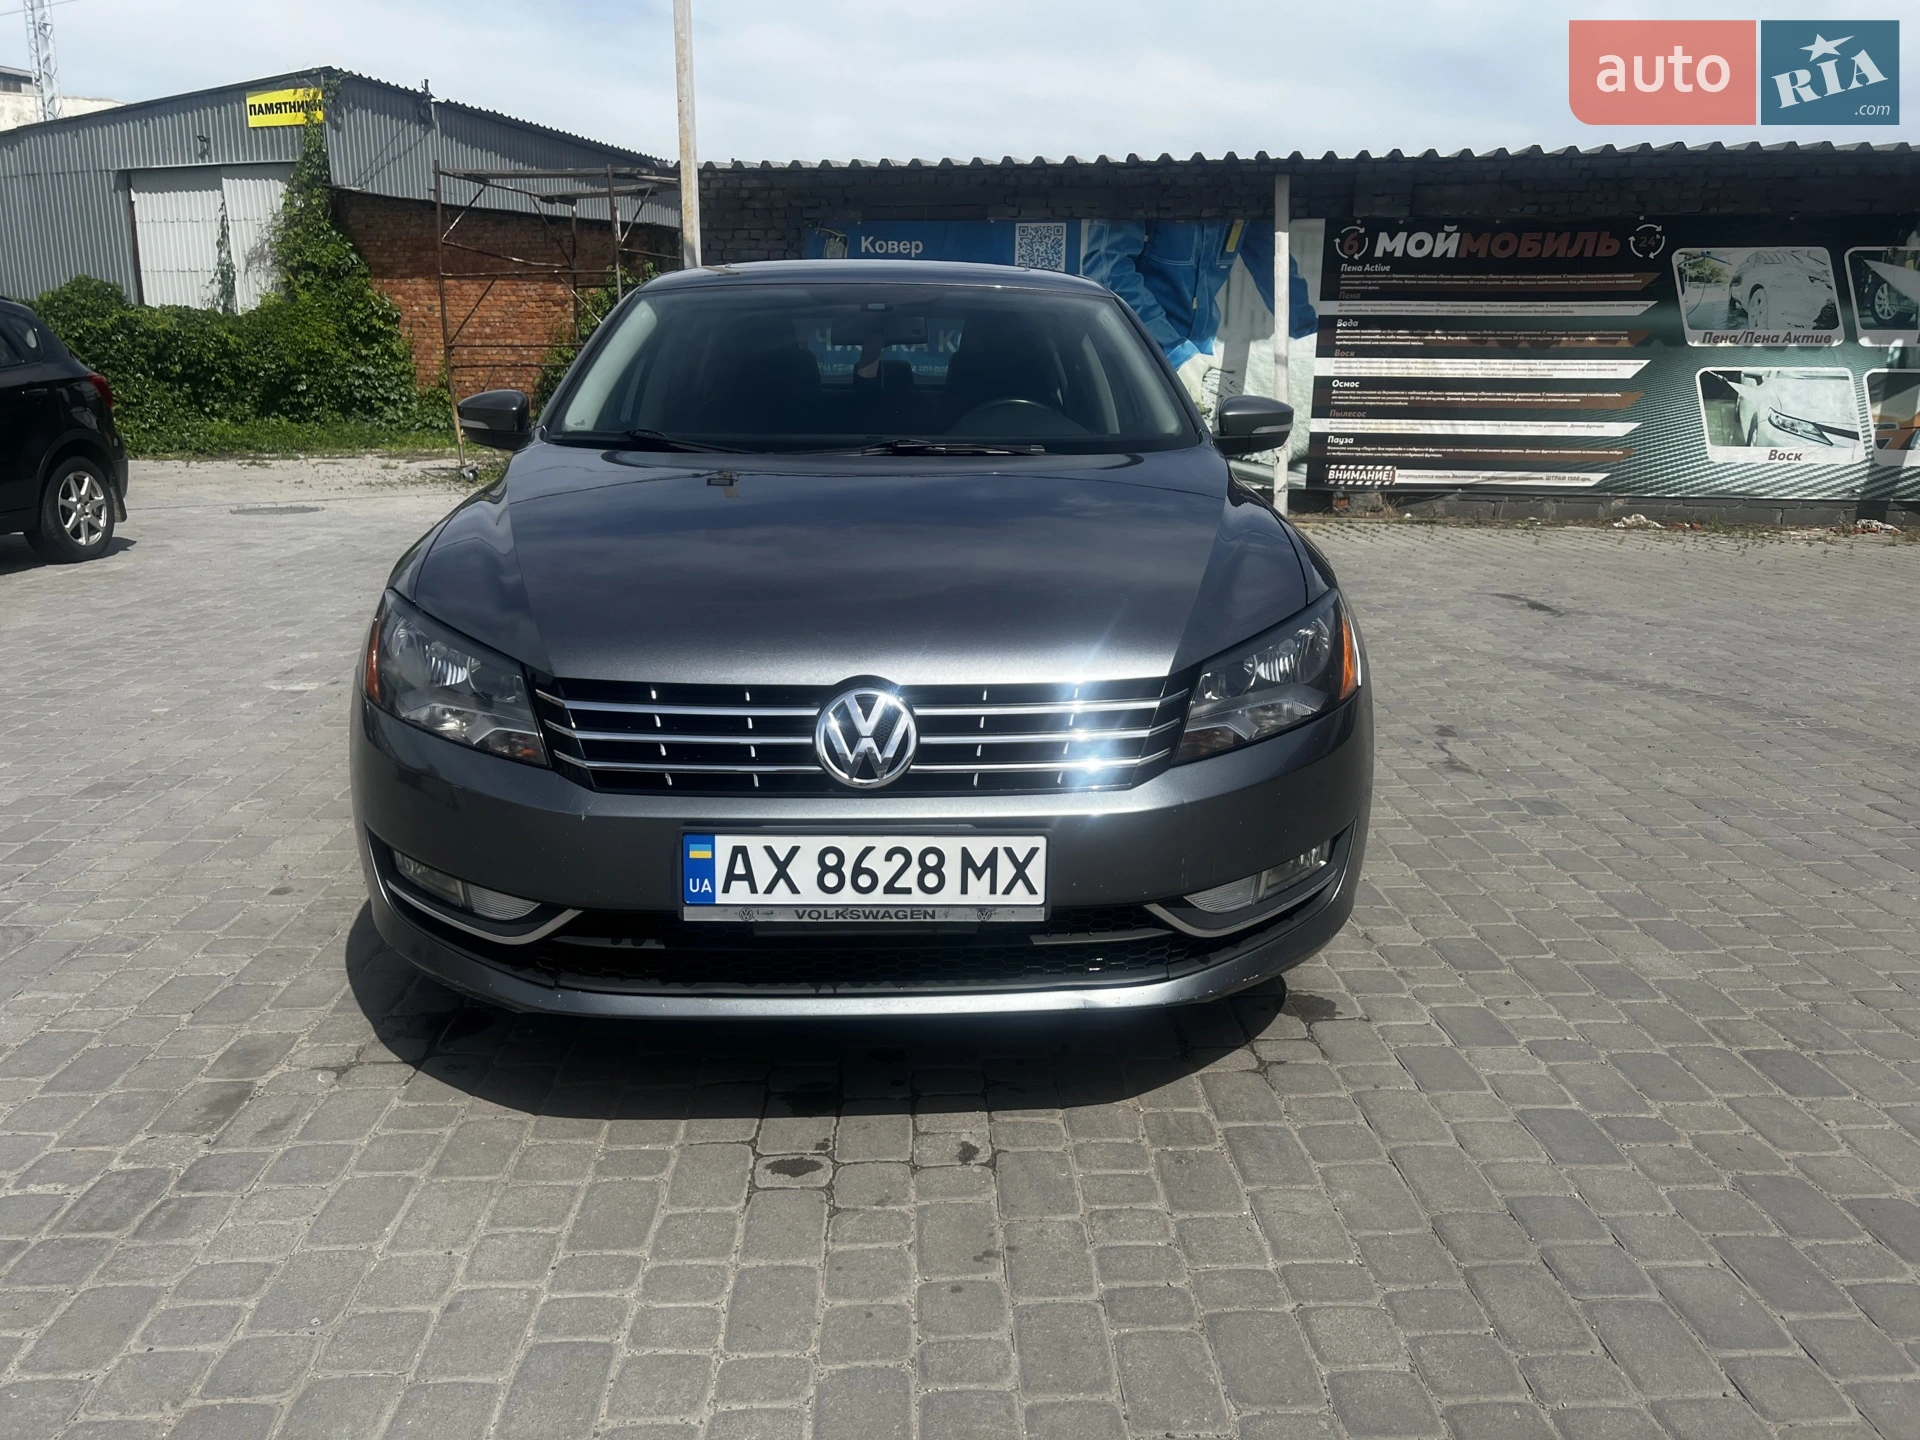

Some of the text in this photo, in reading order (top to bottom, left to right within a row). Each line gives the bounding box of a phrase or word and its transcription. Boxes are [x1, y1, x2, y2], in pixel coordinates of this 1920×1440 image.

[861, 236, 923, 257] Ковер
[1340, 263, 1391, 272] Пена Active
[1339, 291, 1361, 300] Пена
[1336, 319, 1359, 328] Вода
[1702, 331, 1833, 344] Пена/Пена Актив
[1334, 348, 1356, 358] Воск
[1331, 379, 1360, 388] Осмос
[1329, 409, 1367, 418] Пылесос
[1327, 435, 1354, 445] Пауза
[1767, 449, 1802, 461] Воск
[1328, 470, 1393, 480] ВНИМАНИЕ!
[721, 845, 1041, 896] AX 8628 MX
[689, 878, 713, 893] UA
[794, 908, 936, 921] VOLKSWAGEN
